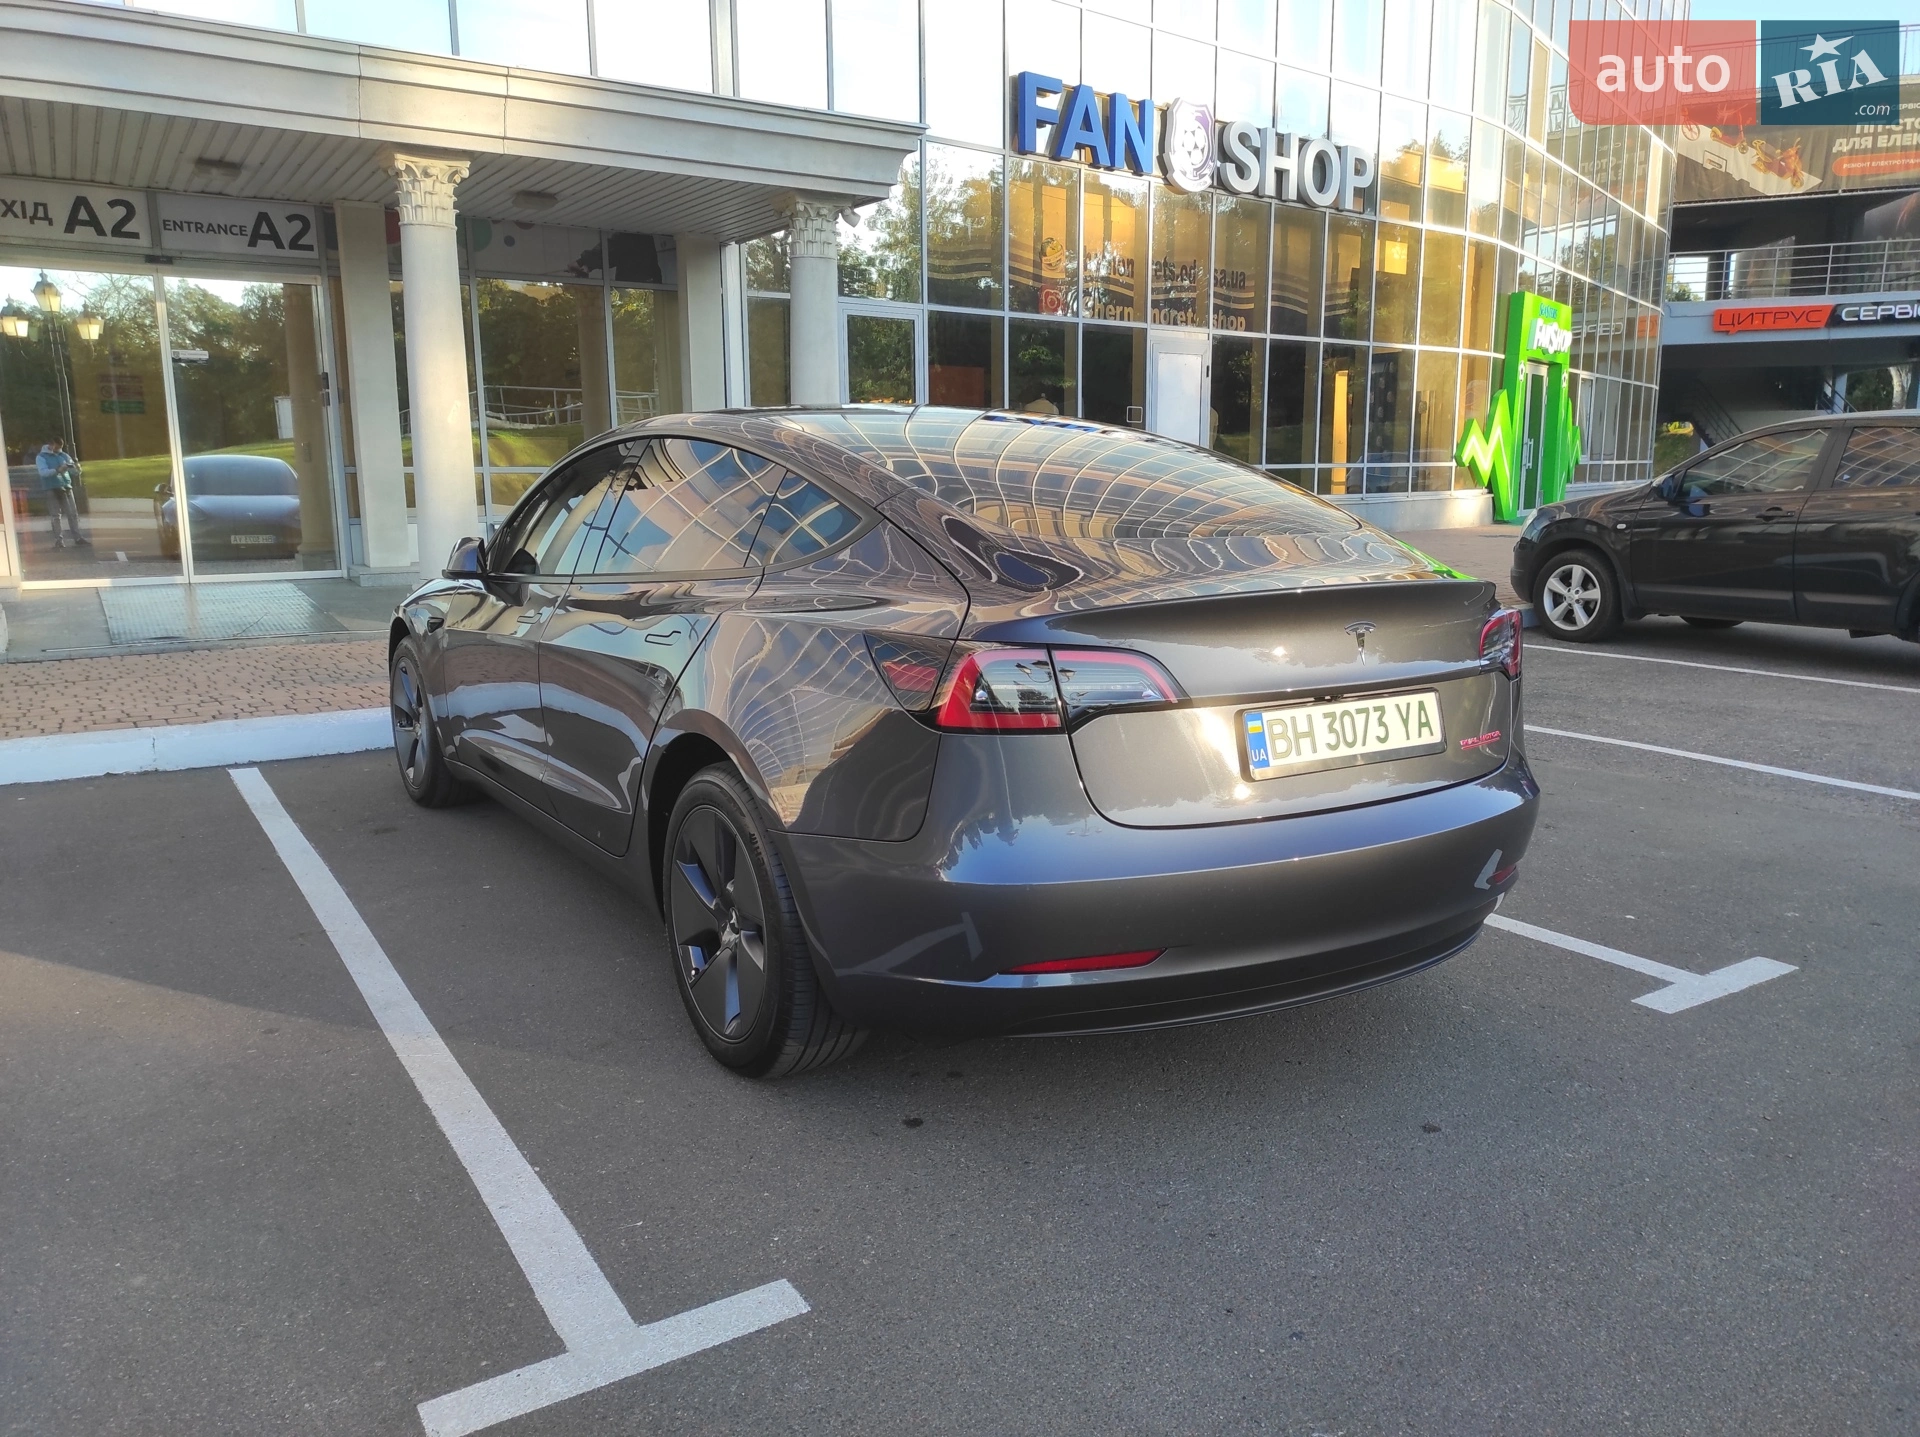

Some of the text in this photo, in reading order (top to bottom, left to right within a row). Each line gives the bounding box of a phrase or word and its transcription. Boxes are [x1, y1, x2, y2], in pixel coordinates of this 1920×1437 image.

[1017, 71, 1375, 211] FAN SHOP
[1832, 136, 1873, 153] ДЛЯ
[1843, 161, 1871, 169] РЕМОНТ
[163, 211, 314, 252] ENTRANCE A2
[1718, 303, 1920, 328] ЦИТРУС СЕРВІ
[1267, 700, 1434, 760] BH 3073 YA
[1251, 748, 1267, 762] UA
